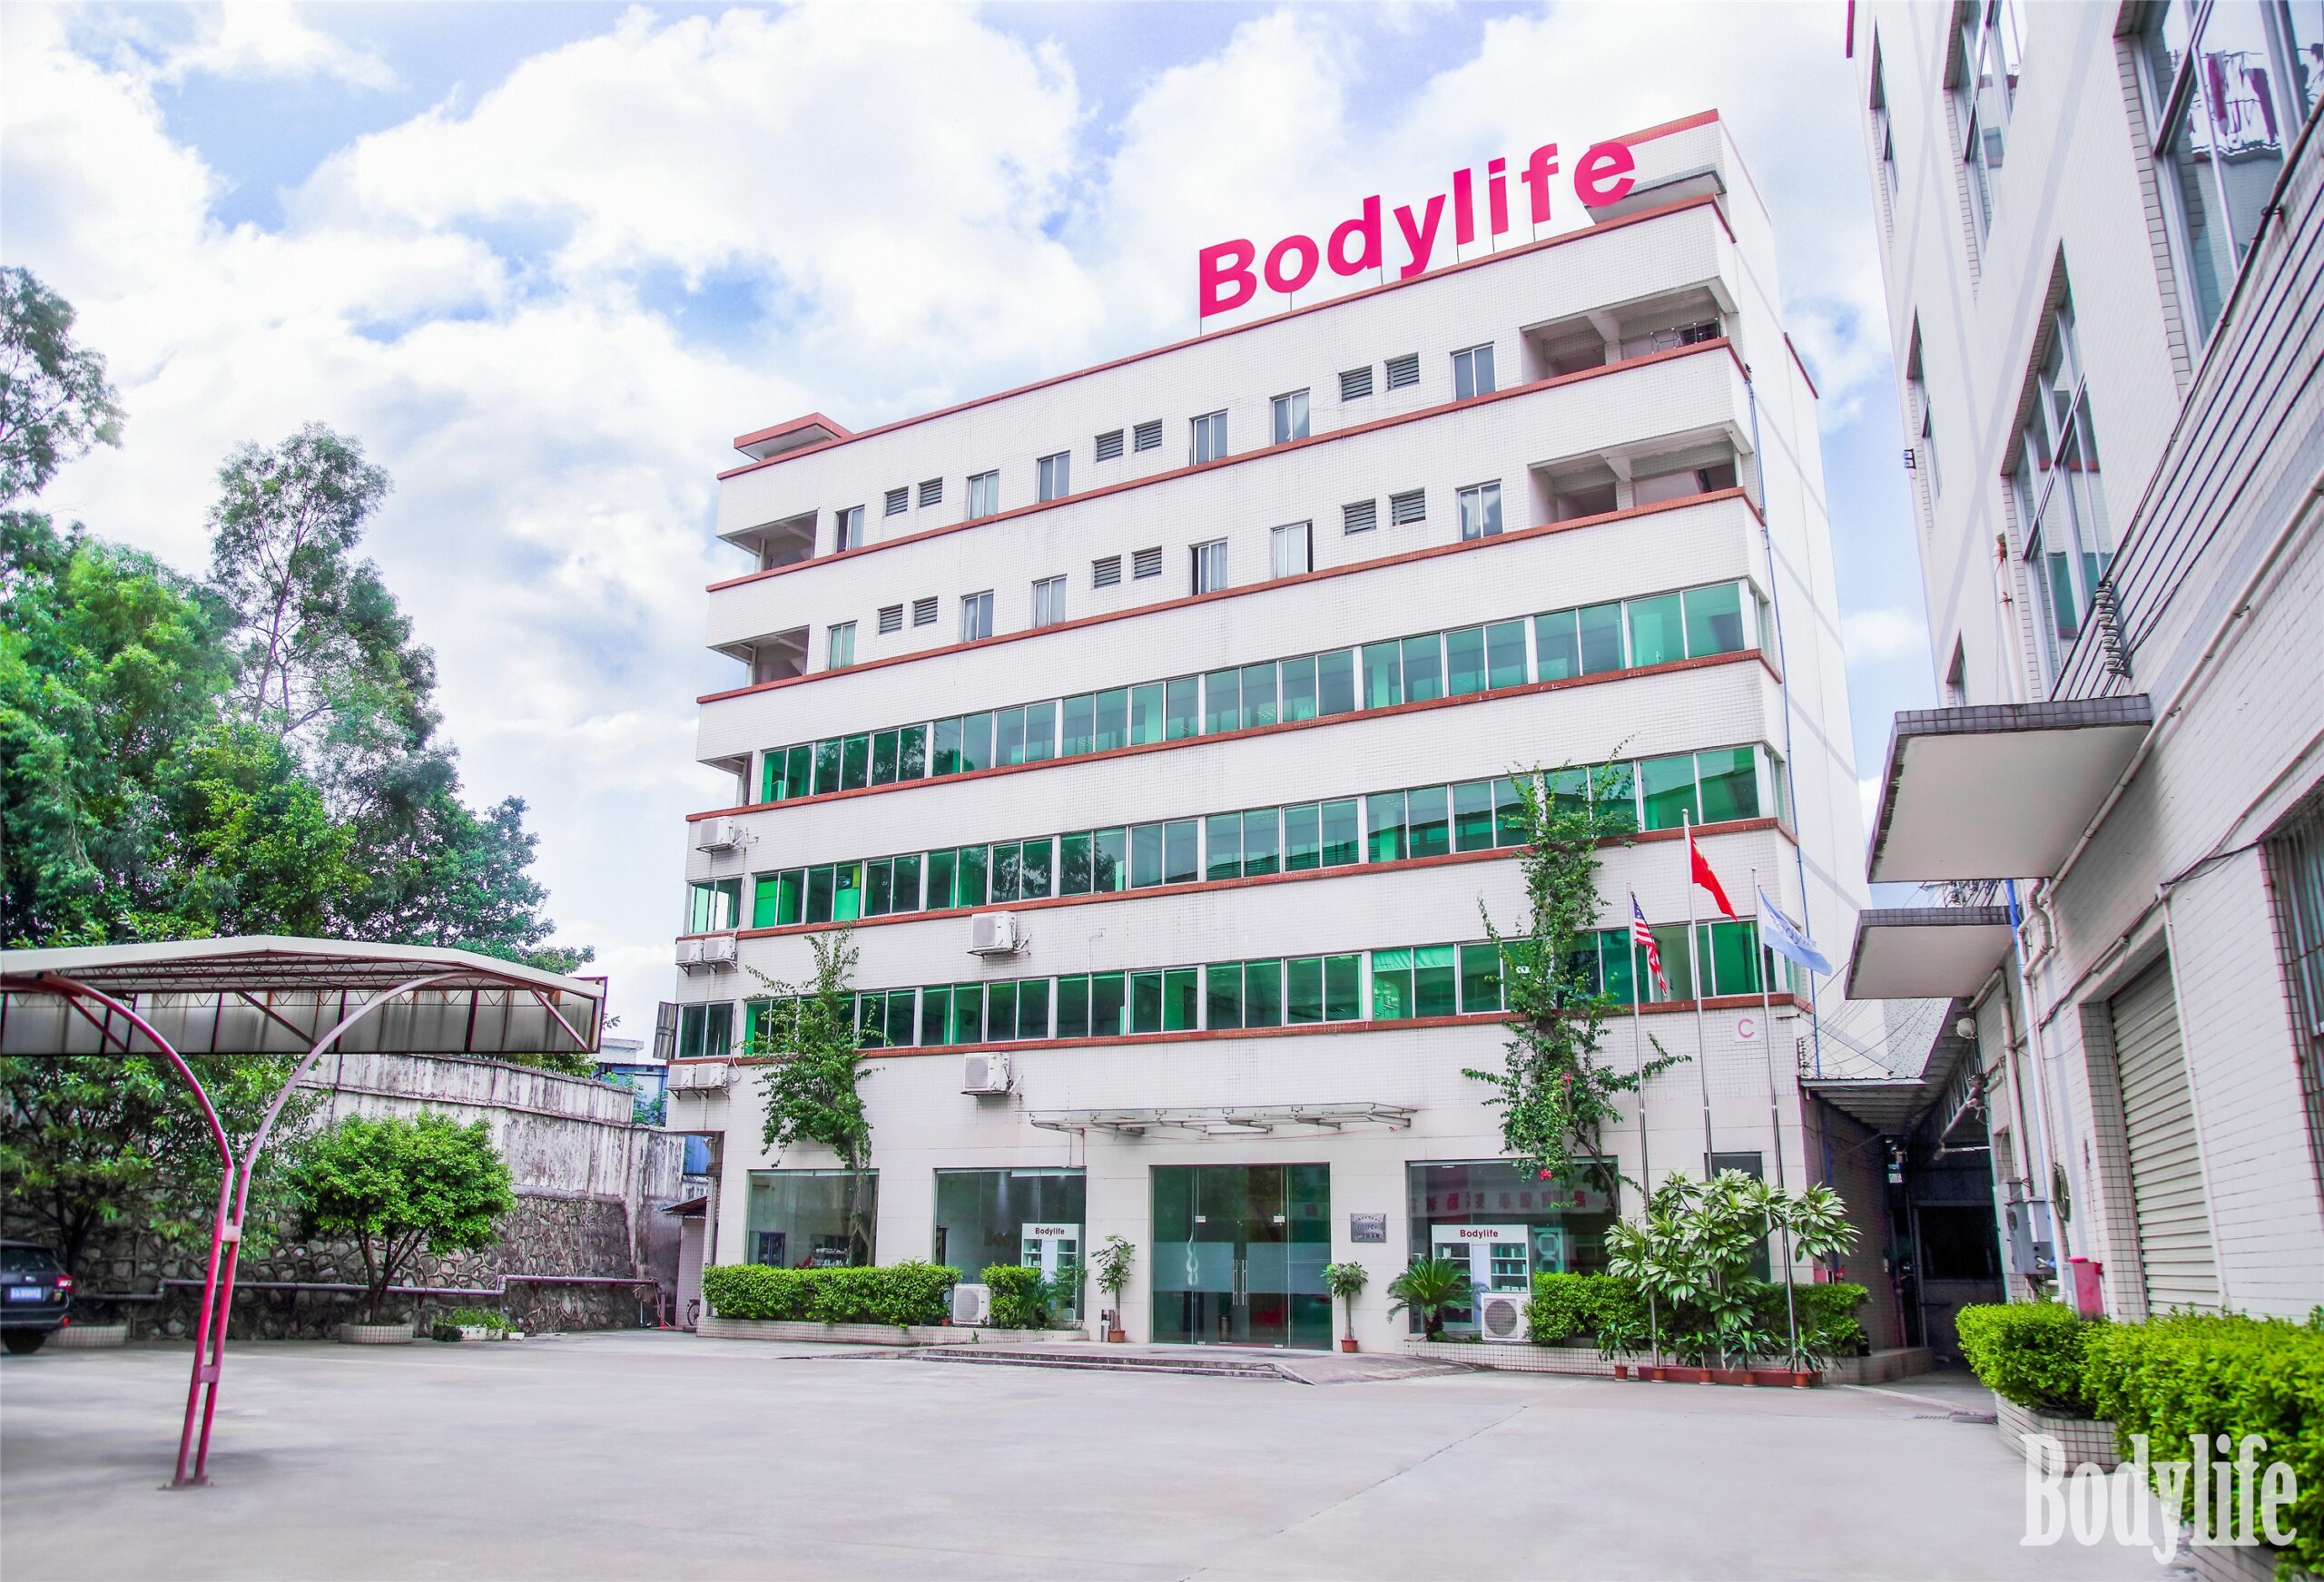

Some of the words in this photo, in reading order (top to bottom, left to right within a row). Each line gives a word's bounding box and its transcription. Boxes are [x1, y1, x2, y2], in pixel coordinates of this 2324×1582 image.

[1199, 142, 1636, 319] Bodylife
[1738, 1017, 1755, 1038] C
[1035, 1227, 1065, 1236] Bodylife
[1460, 1229, 1499, 1239] Bodylife
